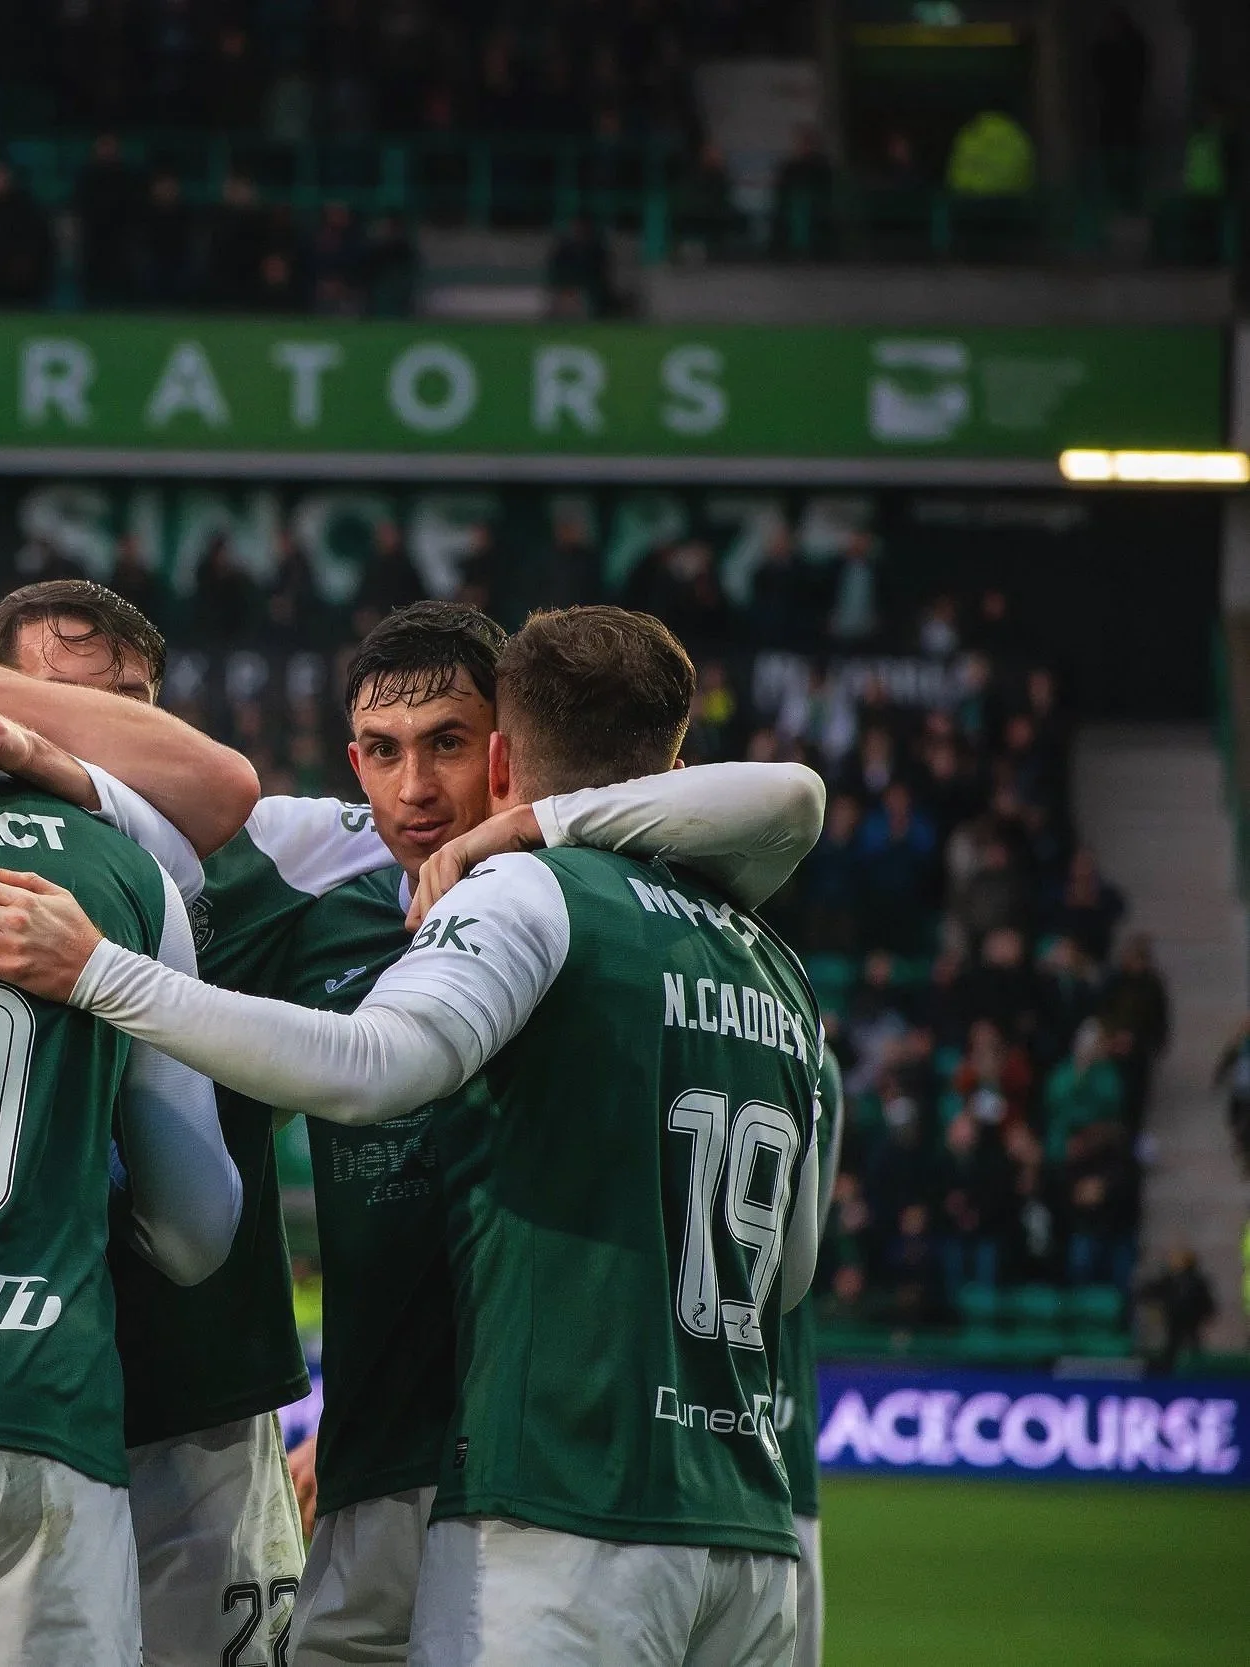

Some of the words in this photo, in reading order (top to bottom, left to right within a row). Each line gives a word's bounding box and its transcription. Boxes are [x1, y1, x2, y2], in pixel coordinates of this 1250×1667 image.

[668, 1087, 801, 1352] 19
[816, 1387, 1240, 1474] ACECOURSE
[219, 1575, 300, 1667] 22
